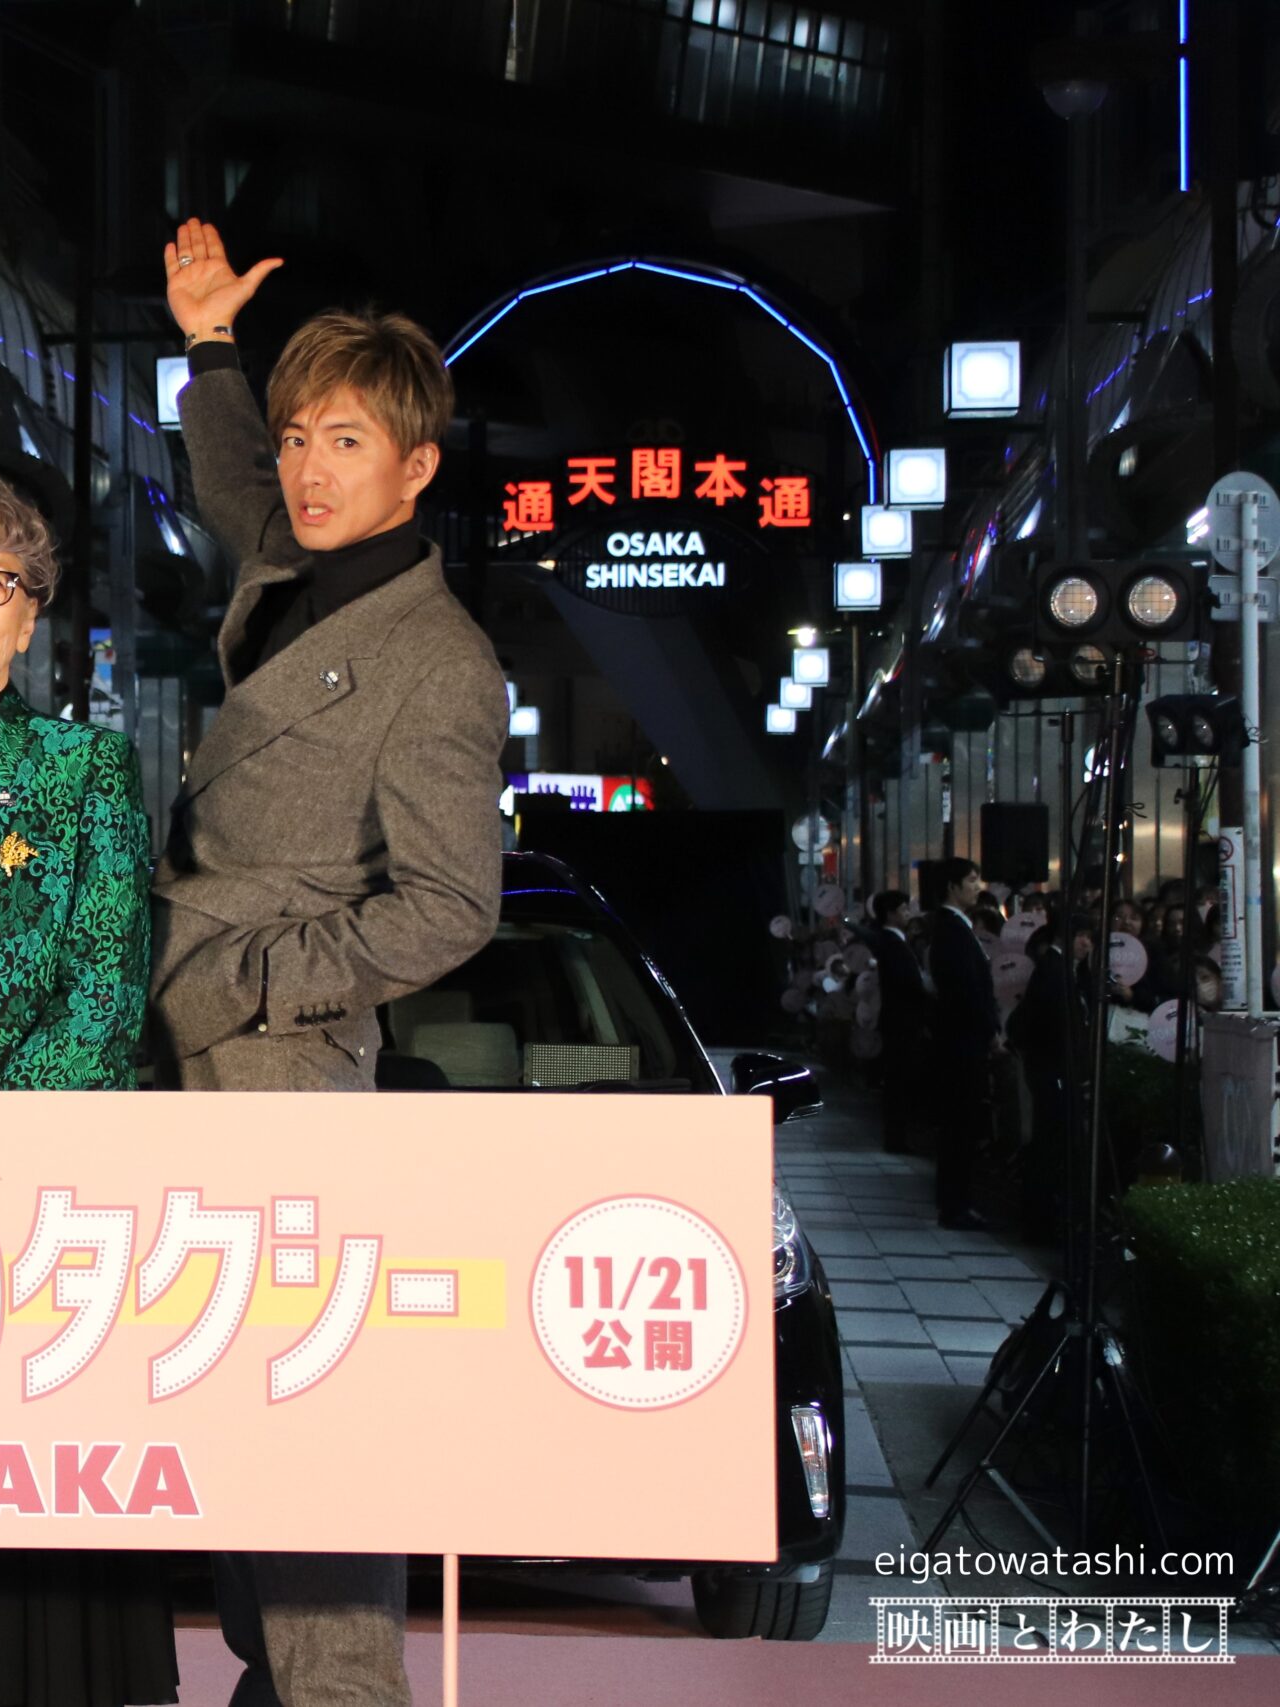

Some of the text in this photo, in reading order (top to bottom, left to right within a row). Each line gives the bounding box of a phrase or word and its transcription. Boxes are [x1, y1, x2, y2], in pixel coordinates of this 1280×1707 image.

[503, 448, 811, 532] 通天閣本通
[607, 532, 705, 557] OSAKA
[586, 562, 725, 588] SHINSEKAI
[564, 1256, 707, 1311] 11/21
[581, 1318, 693, 1371] 公開
